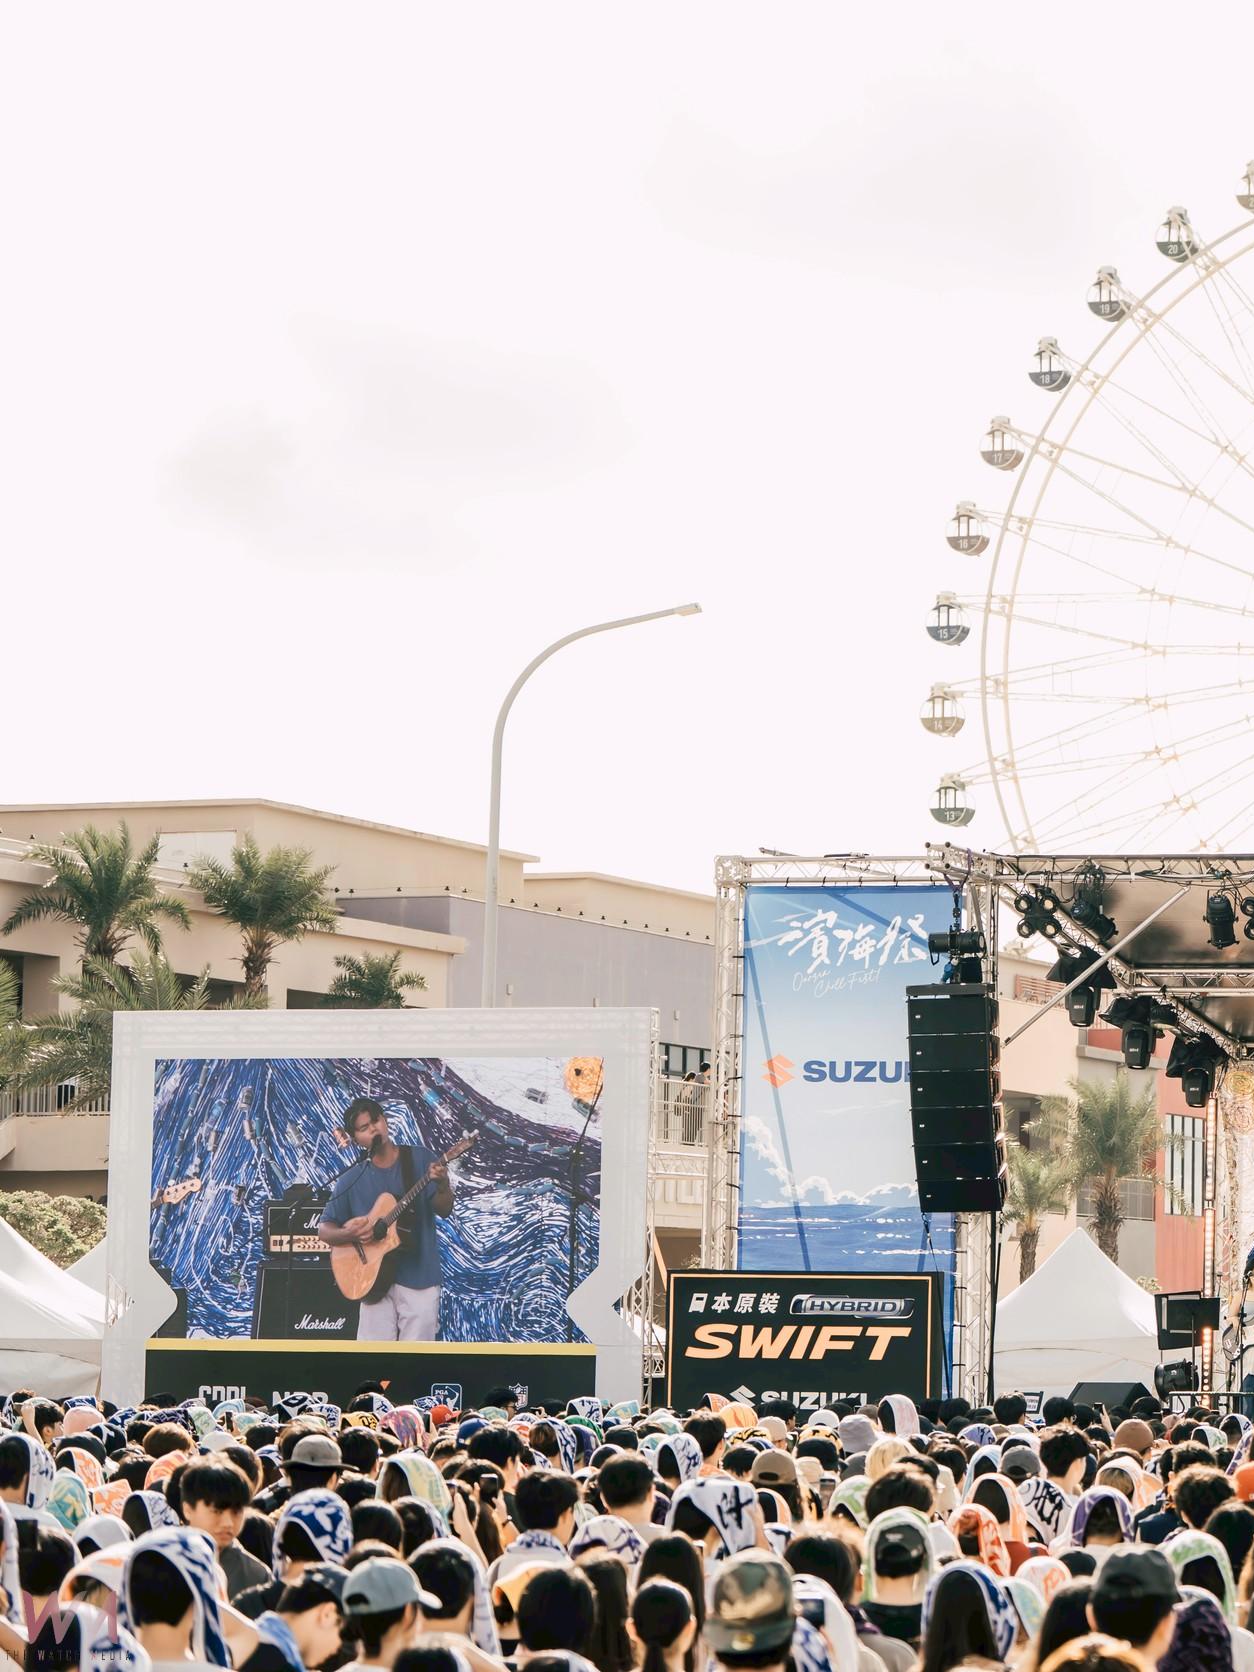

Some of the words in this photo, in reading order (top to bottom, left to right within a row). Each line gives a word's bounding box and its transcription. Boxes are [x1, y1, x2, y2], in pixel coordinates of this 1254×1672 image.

[1168, 244, 1178, 254] 20
[1101, 304, 1110, 313] 19
[1040, 374, 1049, 383] 18
[938, 629, 948, 639] 15
[945, 810, 954, 821] 13
[802, 1060, 911, 1083] SUZU
[688, 1292, 780, 1314] 日本原裝
[810, 1301, 897, 1313] HYBRID
[295, 1314, 346, 1330] Marshall
[684, 1323, 912, 1361] SWIFT
